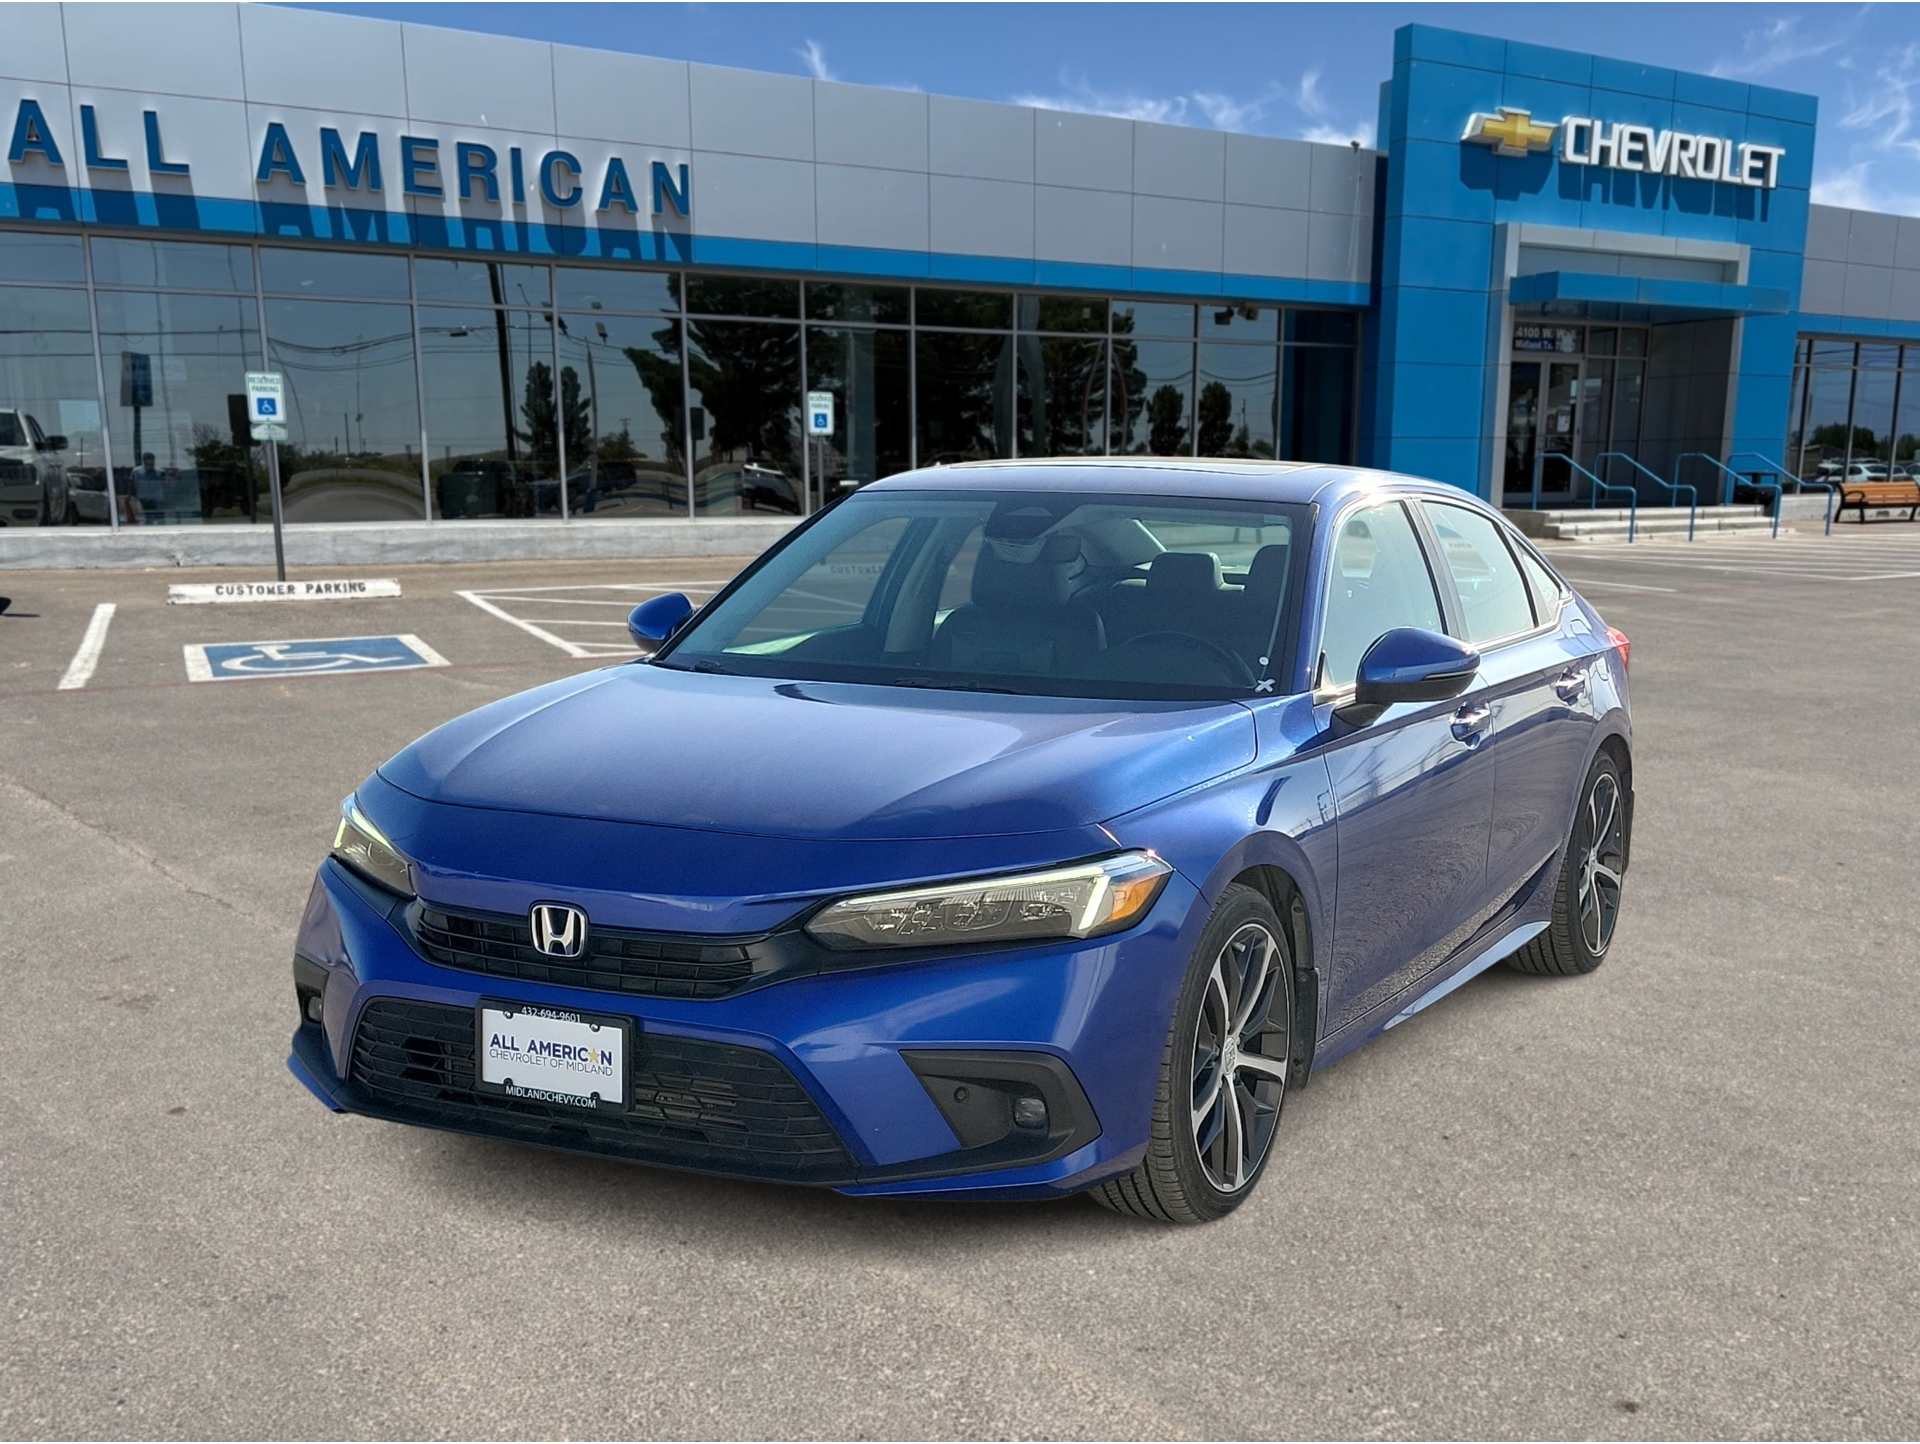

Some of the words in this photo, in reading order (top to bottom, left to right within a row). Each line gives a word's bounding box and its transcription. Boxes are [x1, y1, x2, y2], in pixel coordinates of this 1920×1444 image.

[8, 98, 190, 175] ALL
[256, 121, 691, 217] AMERICAN
[1560, 114, 1786, 189] CHEVROLET
[215, 584, 296, 596] CUSTOMER
[305, 582, 367, 594] PARKING
[521, 1006, 582, 1023] 432-694-9601
[489, 1033, 520, 1051] ALL
[489, 1048, 547, 1067] CHEVROLET
[550, 1058, 564, 1069] OF
[566, 1060, 613, 1077] MIDLAND
[505, 1085, 597, 1109] MIDLANDCHEVY.COM
